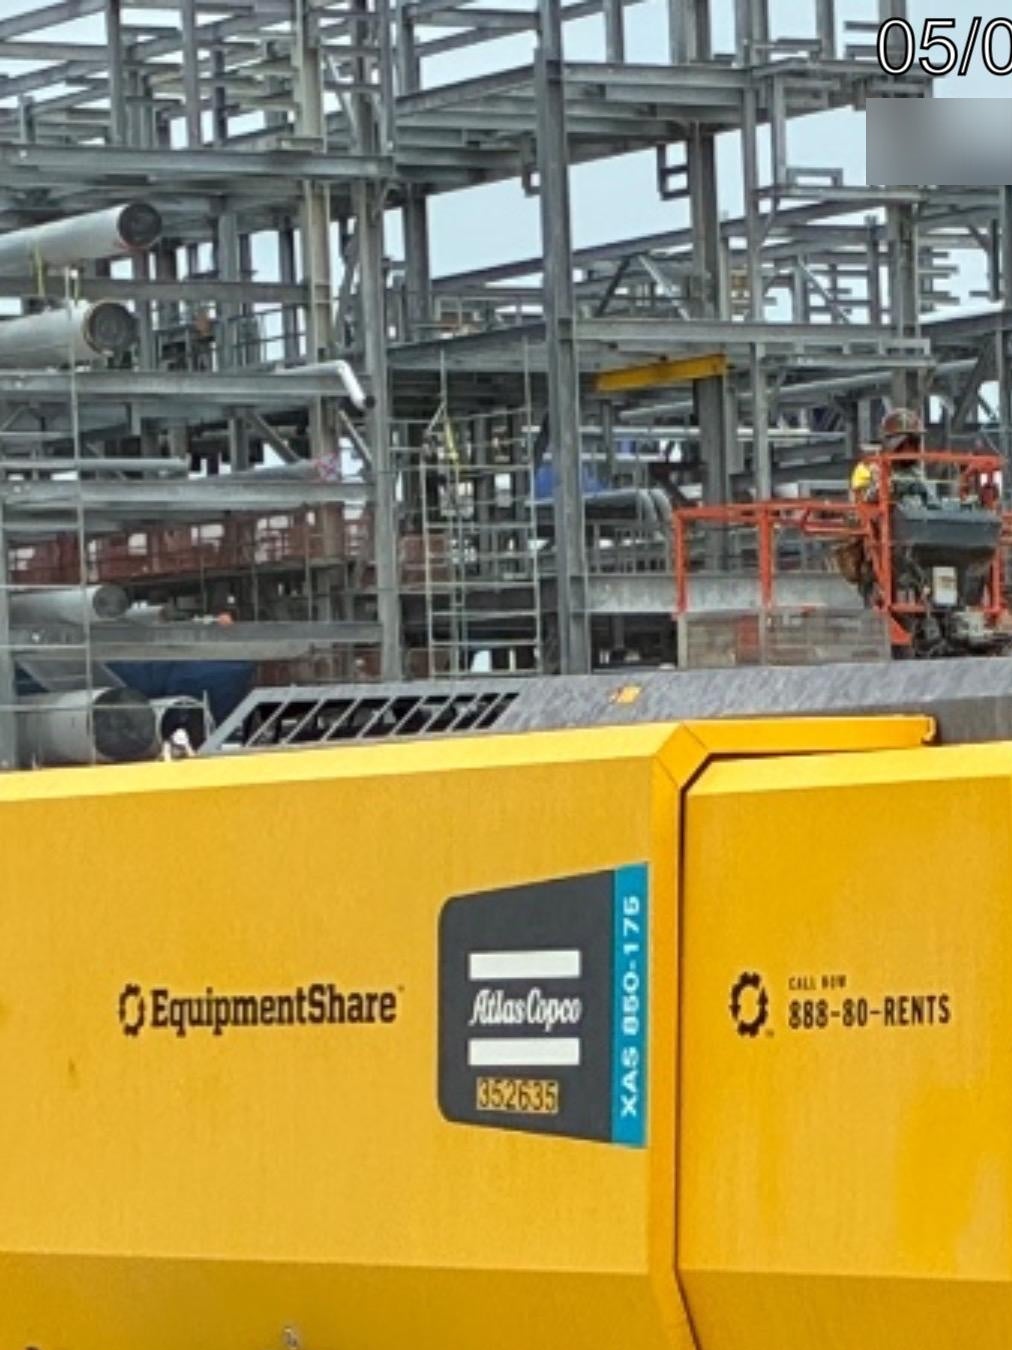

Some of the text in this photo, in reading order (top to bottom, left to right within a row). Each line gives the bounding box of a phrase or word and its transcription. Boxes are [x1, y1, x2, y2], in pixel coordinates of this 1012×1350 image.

[787, 976, 817, 990] CALL
[151, 984, 396, 1037] EquipmentShare
[468, 986, 582, 1033] Atlas Copco
[788, 994, 951, 1030] 888-80-RENTS
[477, 1079, 557, 1111] 352635
[621, 1046, 640, 1118] XAS
